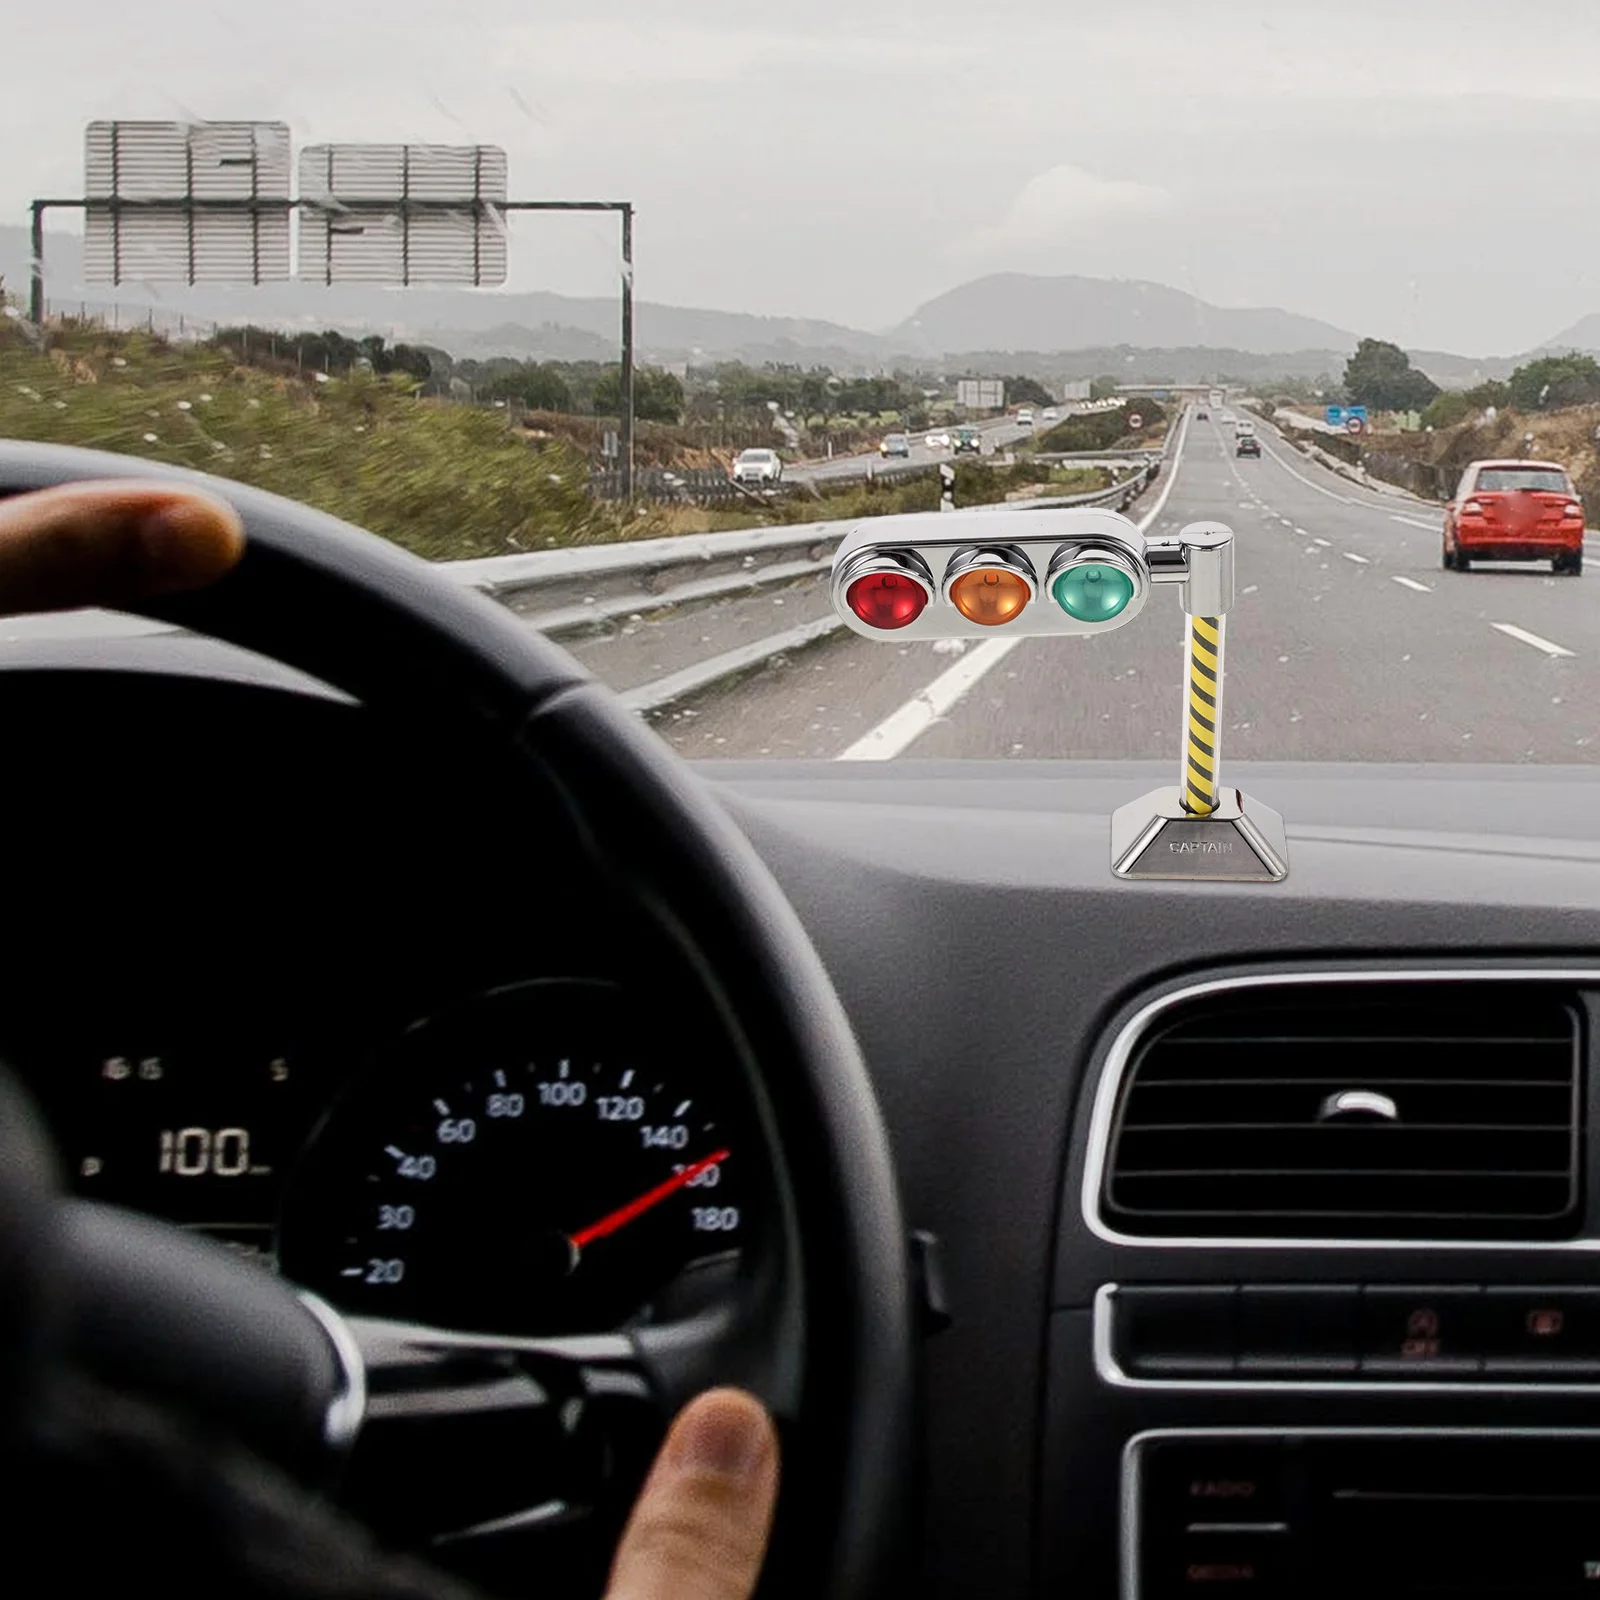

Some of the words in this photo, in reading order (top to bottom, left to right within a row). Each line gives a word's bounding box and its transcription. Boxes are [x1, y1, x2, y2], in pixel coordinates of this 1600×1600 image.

[1169, 841, 1232, 855] CAPTAIN
[486, 1093, 524, 1117] 80
[537, 1081, 586, 1106] 100
[595, 1096, 645, 1121] 120
[436, 1118, 476, 1144] 60
[640, 1124, 689, 1149] 140
[159, 1127, 249, 1176] 100
[397, 1155, 436, 1180] 40
[377, 1204, 415, 1230] 30
[691, 1206, 740, 1231] 180
[364, 1258, 405, 1284] 20
